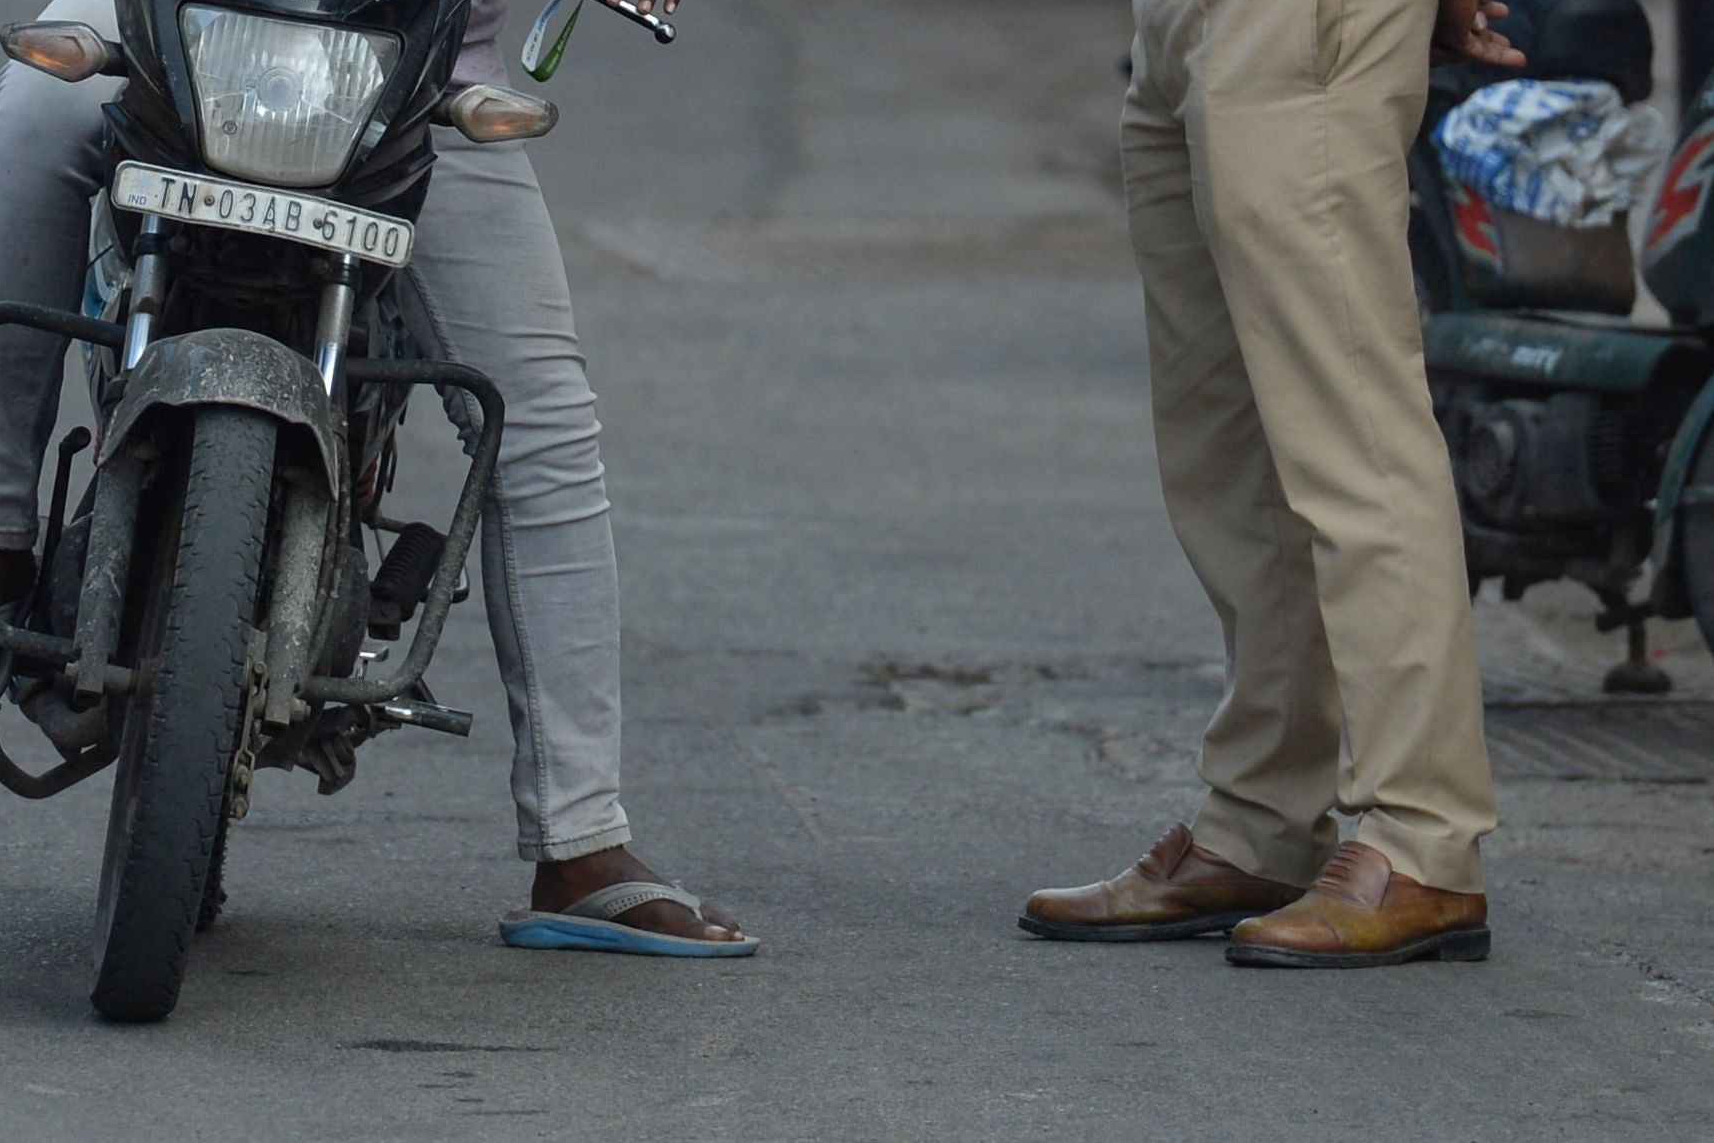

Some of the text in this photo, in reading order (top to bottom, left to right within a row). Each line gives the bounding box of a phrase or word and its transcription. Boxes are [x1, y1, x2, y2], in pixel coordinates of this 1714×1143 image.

[127, 193, 148, 207] IND
[159, 177, 399, 257] TN 03AB 6100
